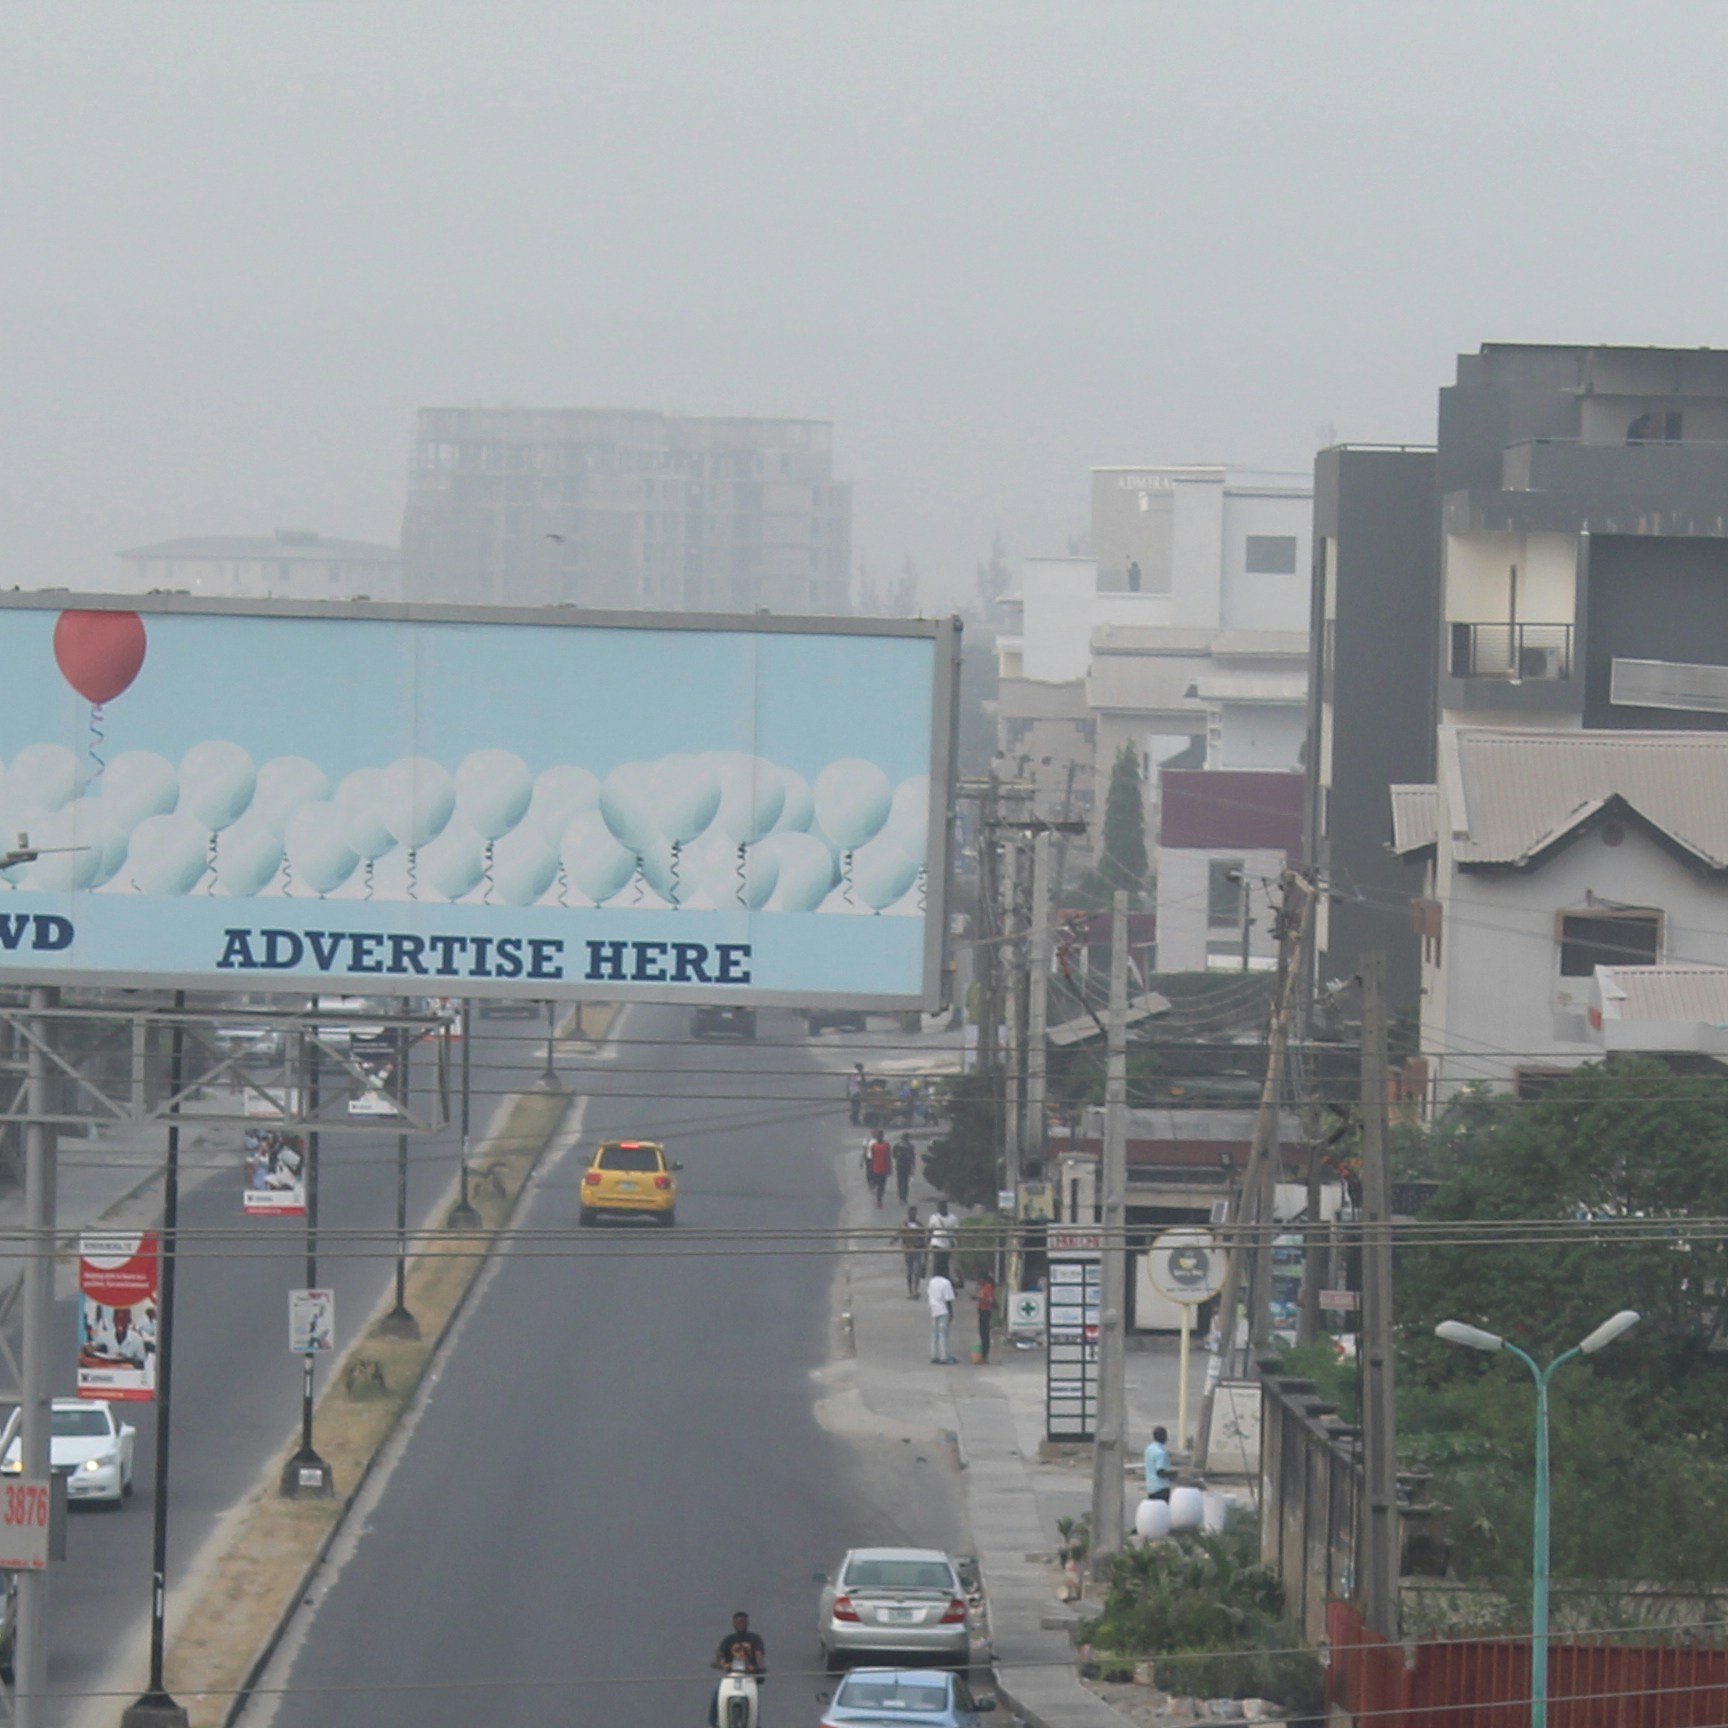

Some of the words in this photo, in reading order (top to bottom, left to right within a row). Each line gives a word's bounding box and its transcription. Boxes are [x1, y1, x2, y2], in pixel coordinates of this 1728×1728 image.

[216, 929, 563, 980] ADVERTISE
[585, 939, 754, 985] HERE
[4, 1485, 48, 1527] 3876
